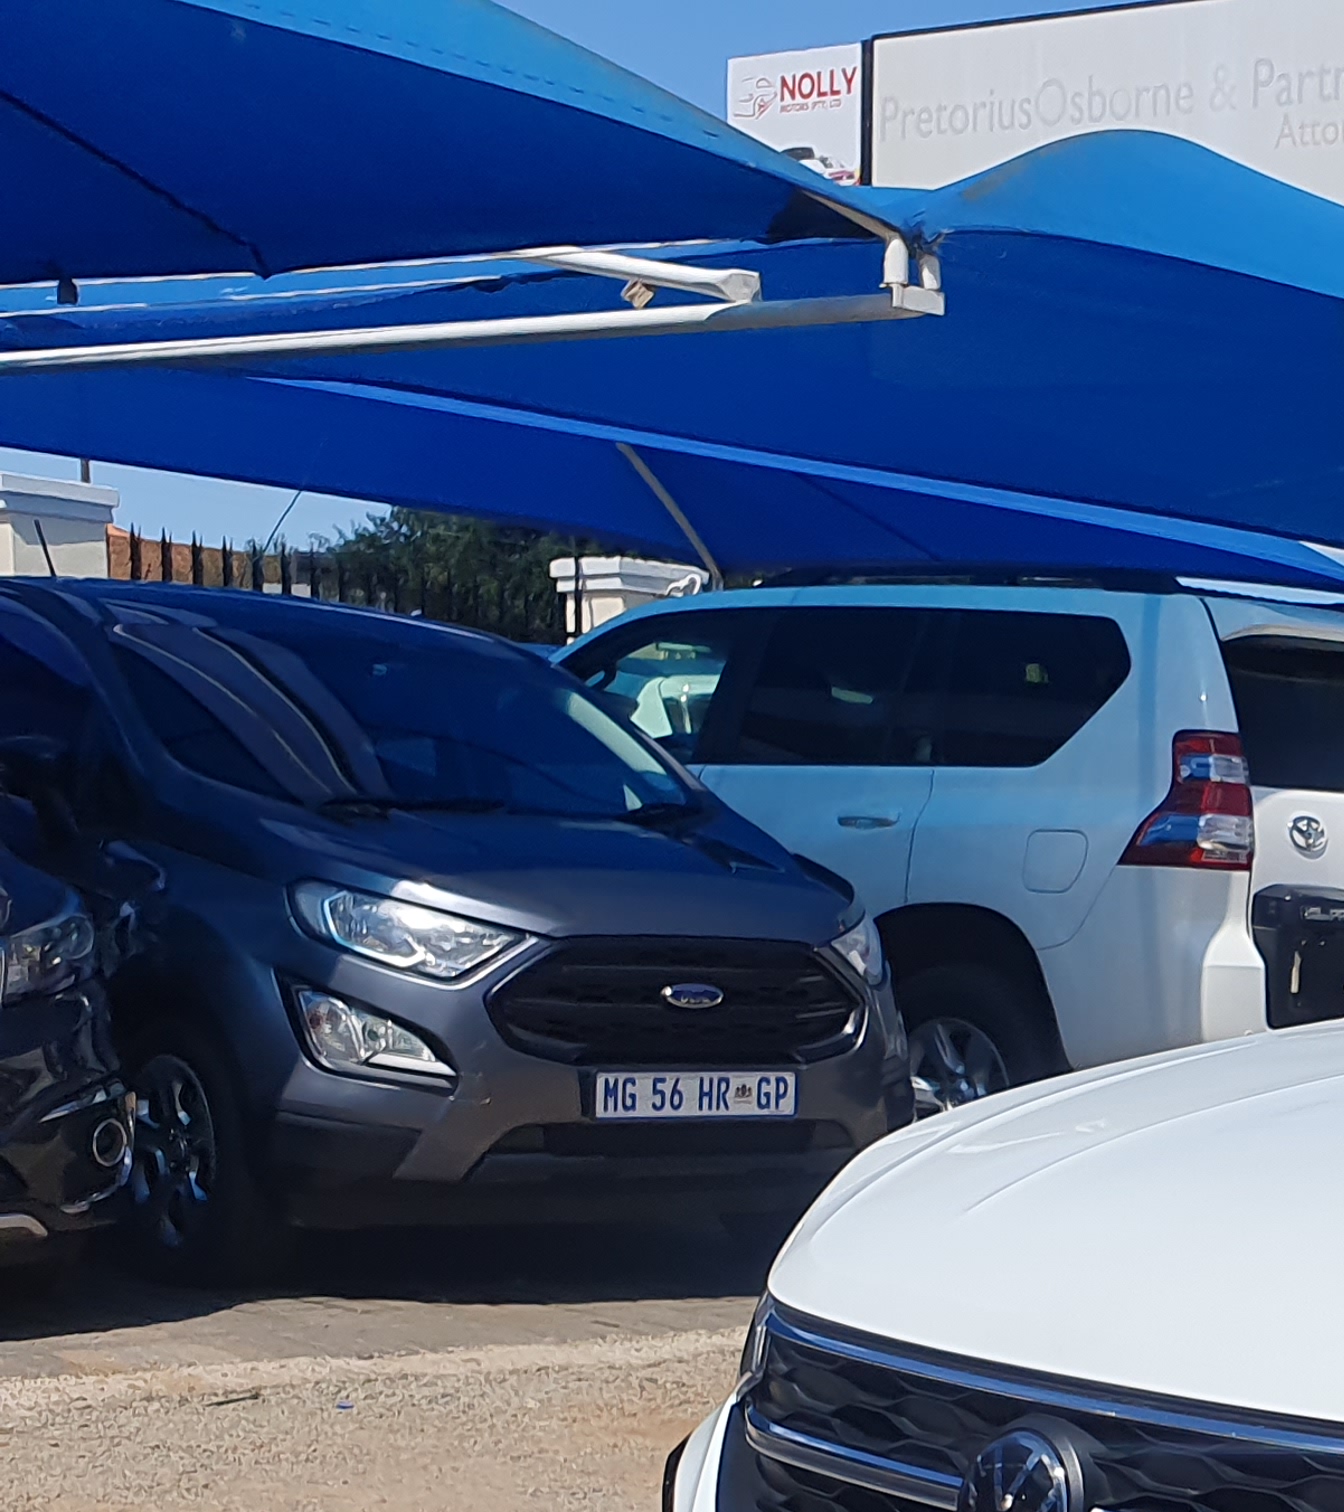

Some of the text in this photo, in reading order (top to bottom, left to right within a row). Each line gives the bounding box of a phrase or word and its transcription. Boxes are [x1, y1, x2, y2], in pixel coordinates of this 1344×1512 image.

[780, 66, 857, 102] NOLLY
[1209, 63, 1237, 112] &
[603, 1076, 788, 1112] MG 56 HR GP
